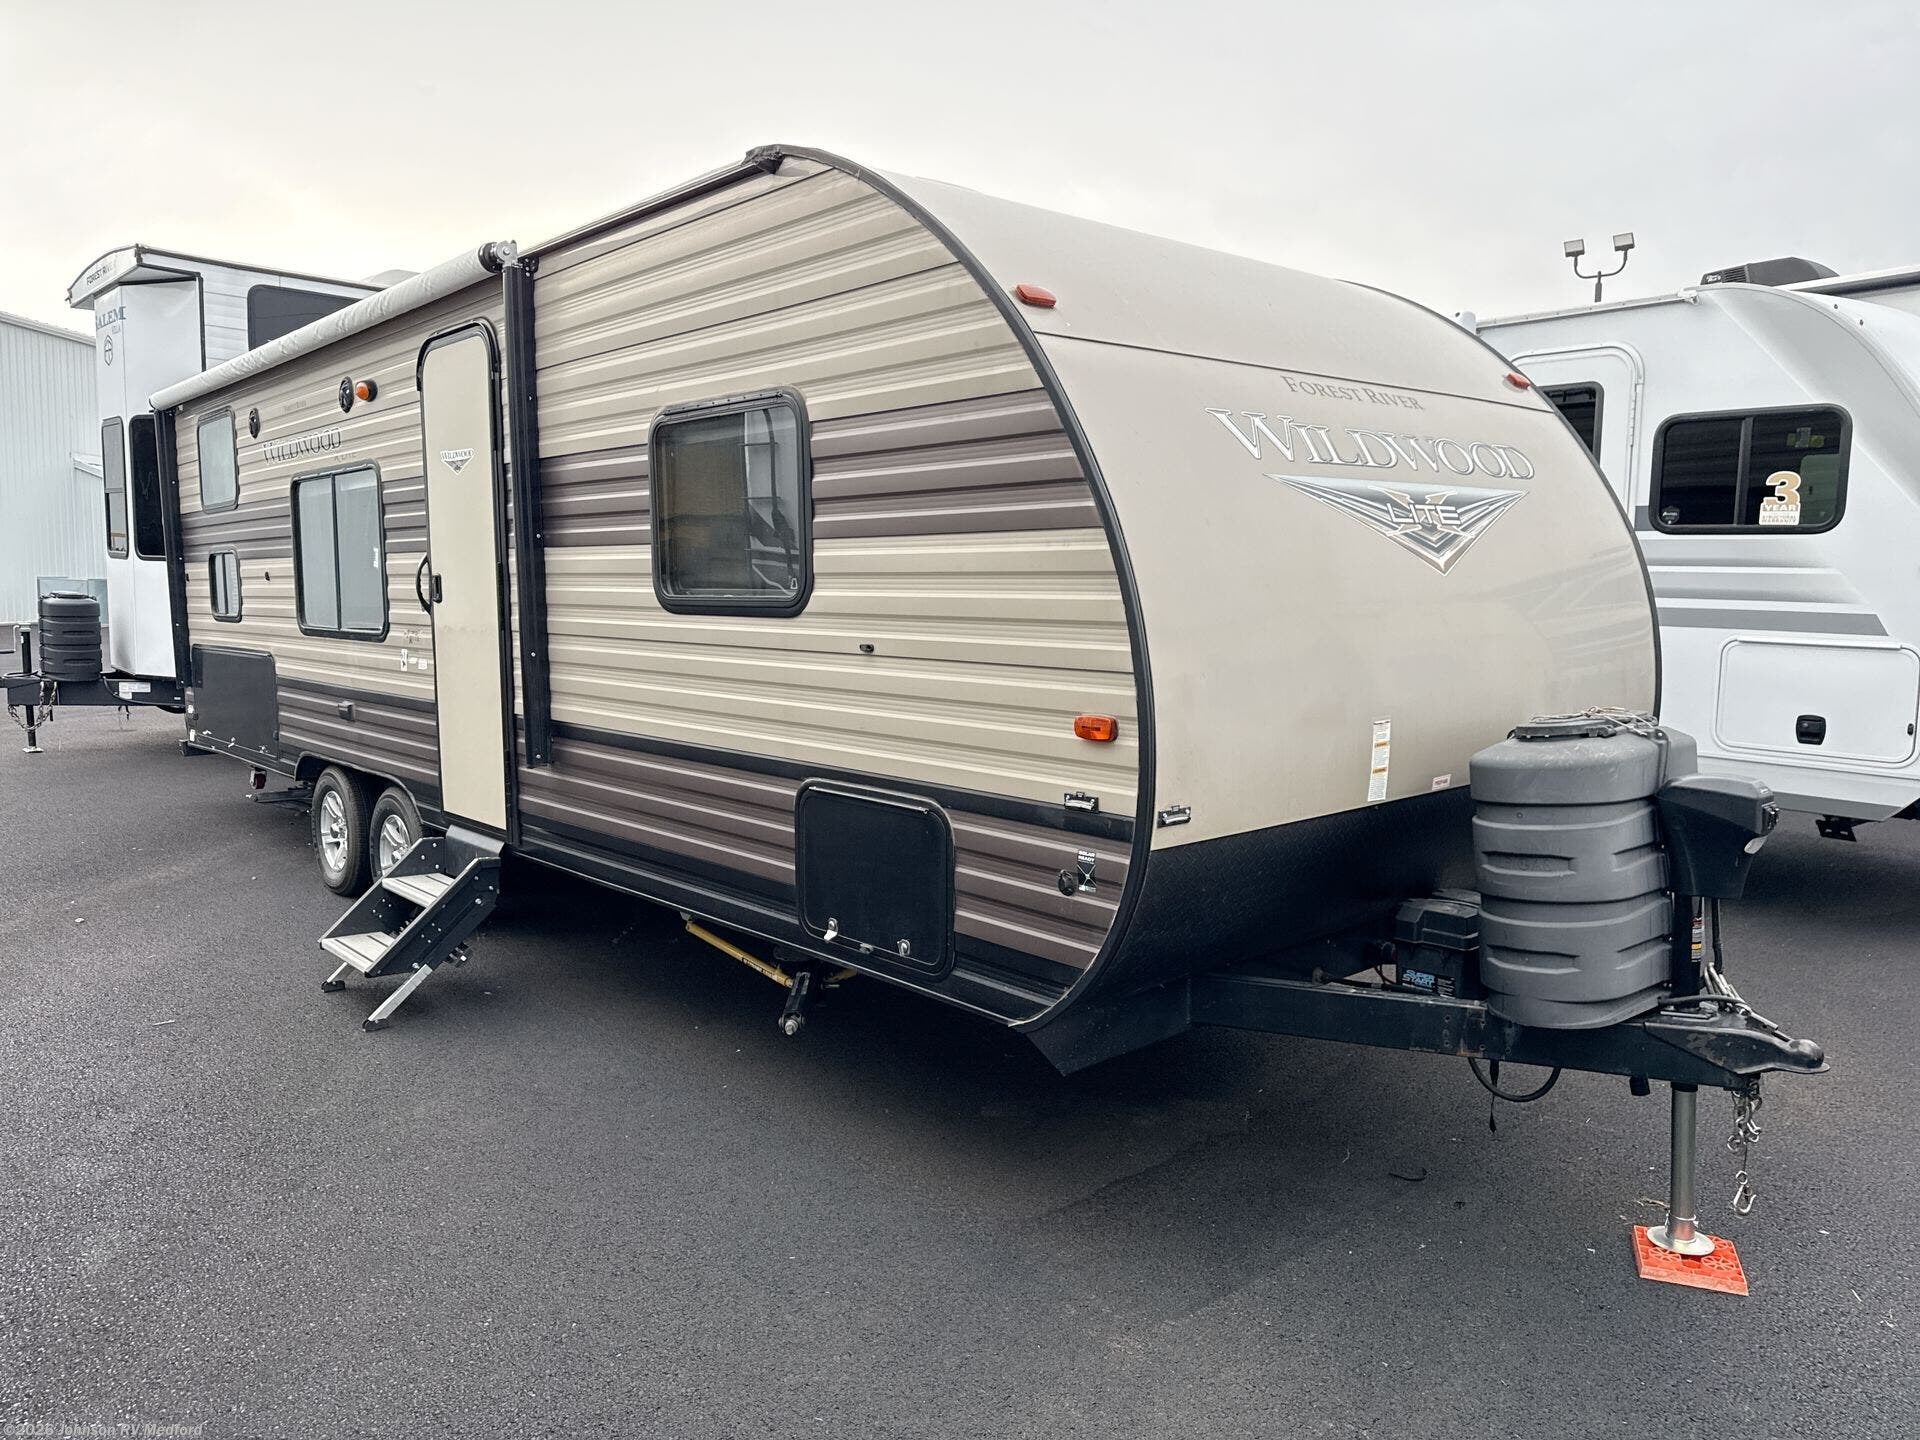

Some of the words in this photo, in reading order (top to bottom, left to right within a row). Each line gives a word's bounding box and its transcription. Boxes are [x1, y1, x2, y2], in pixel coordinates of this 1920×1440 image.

[1281, 375, 1362, 402] FOREST
[1361, 386, 1425, 410] RIVER
[263, 427, 341, 463] WILDWOOD
[1204, 407, 1535, 480] WILDWOOD
[1763, 470, 1801, 505] 3
[1386, 502, 1462, 526] LITE
[1762, 503, 1799, 512] YEAR
